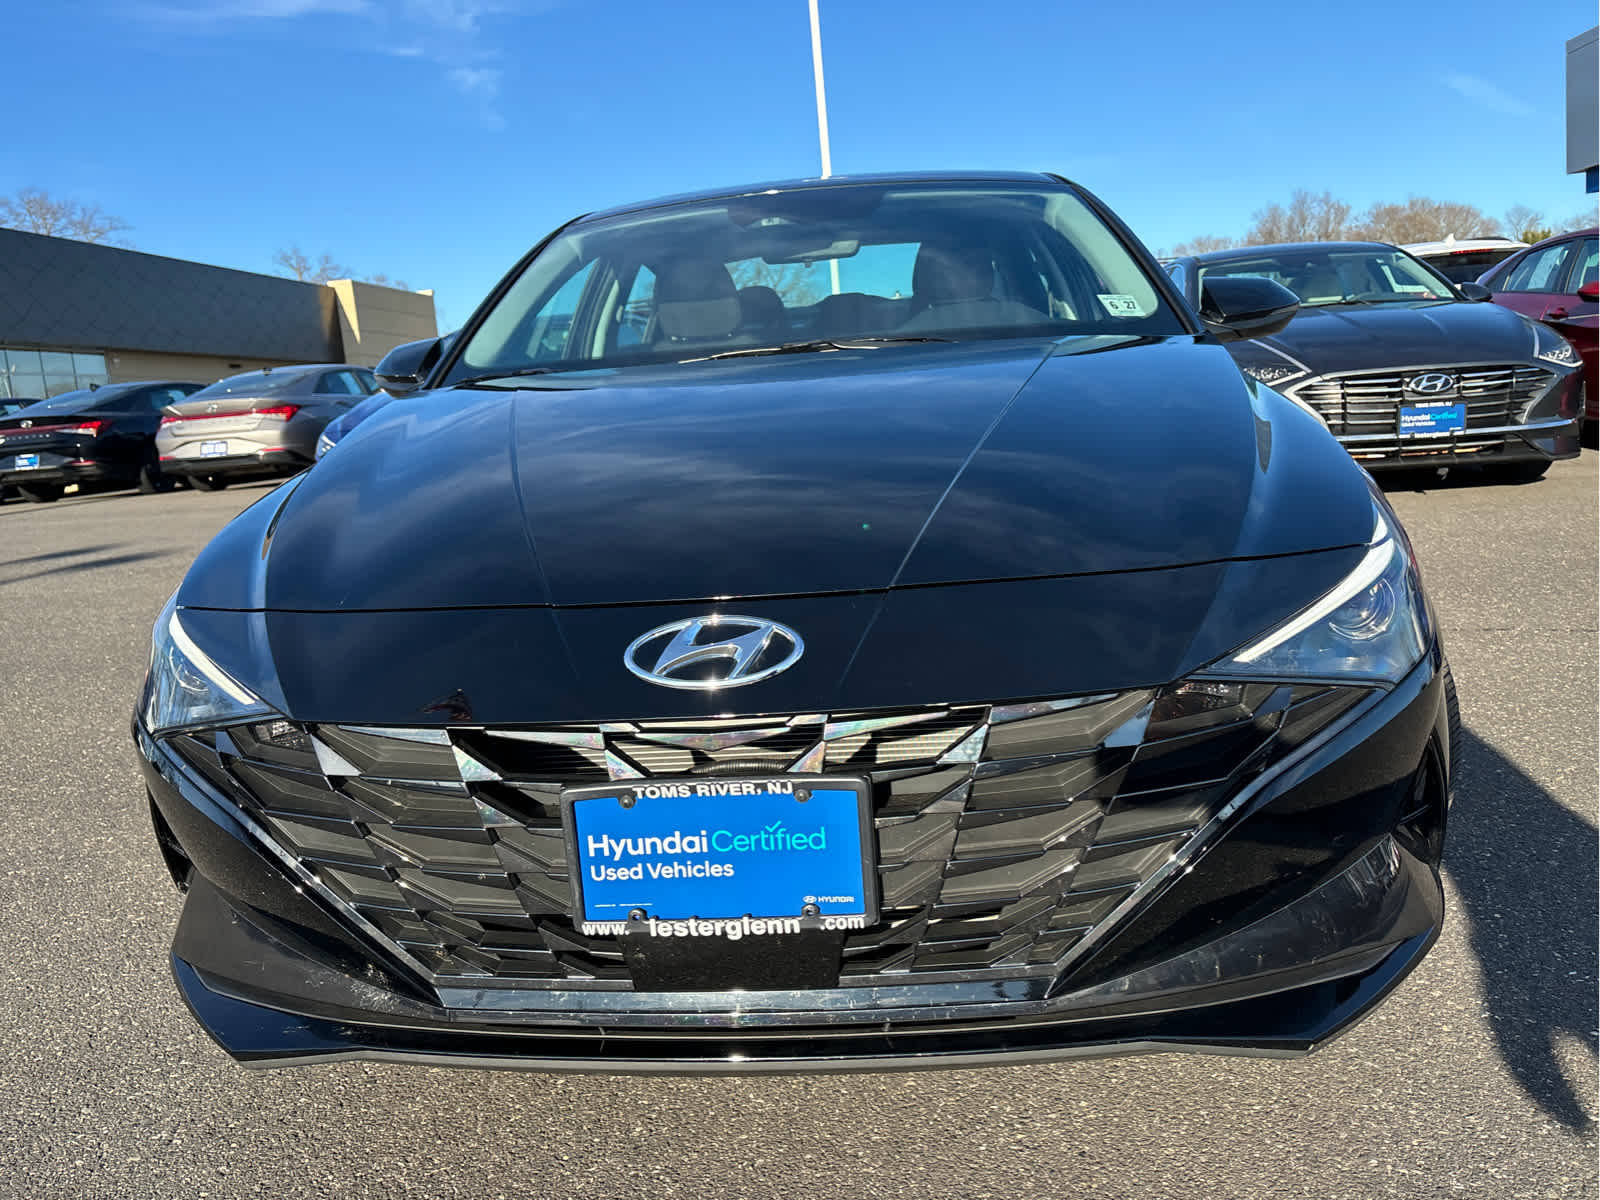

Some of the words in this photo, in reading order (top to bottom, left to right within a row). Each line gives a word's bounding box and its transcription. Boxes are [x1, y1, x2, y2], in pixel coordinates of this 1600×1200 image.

[1109, 301, 1119, 309] 6
[632, 785, 691, 799] TOMS
[696, 783, 762, 797] RIVER,
[767, 781, 793, 795] NJ
[587, 830, 708, 861] Hyundai
[711, 821, 826, 852] Certified
[590, 863, 643, 881] Used
[646, 860, 735, 879] Vehicles
[649, 917, 800, 940] lesterglenn
[820, 917, 865, 931] .com
